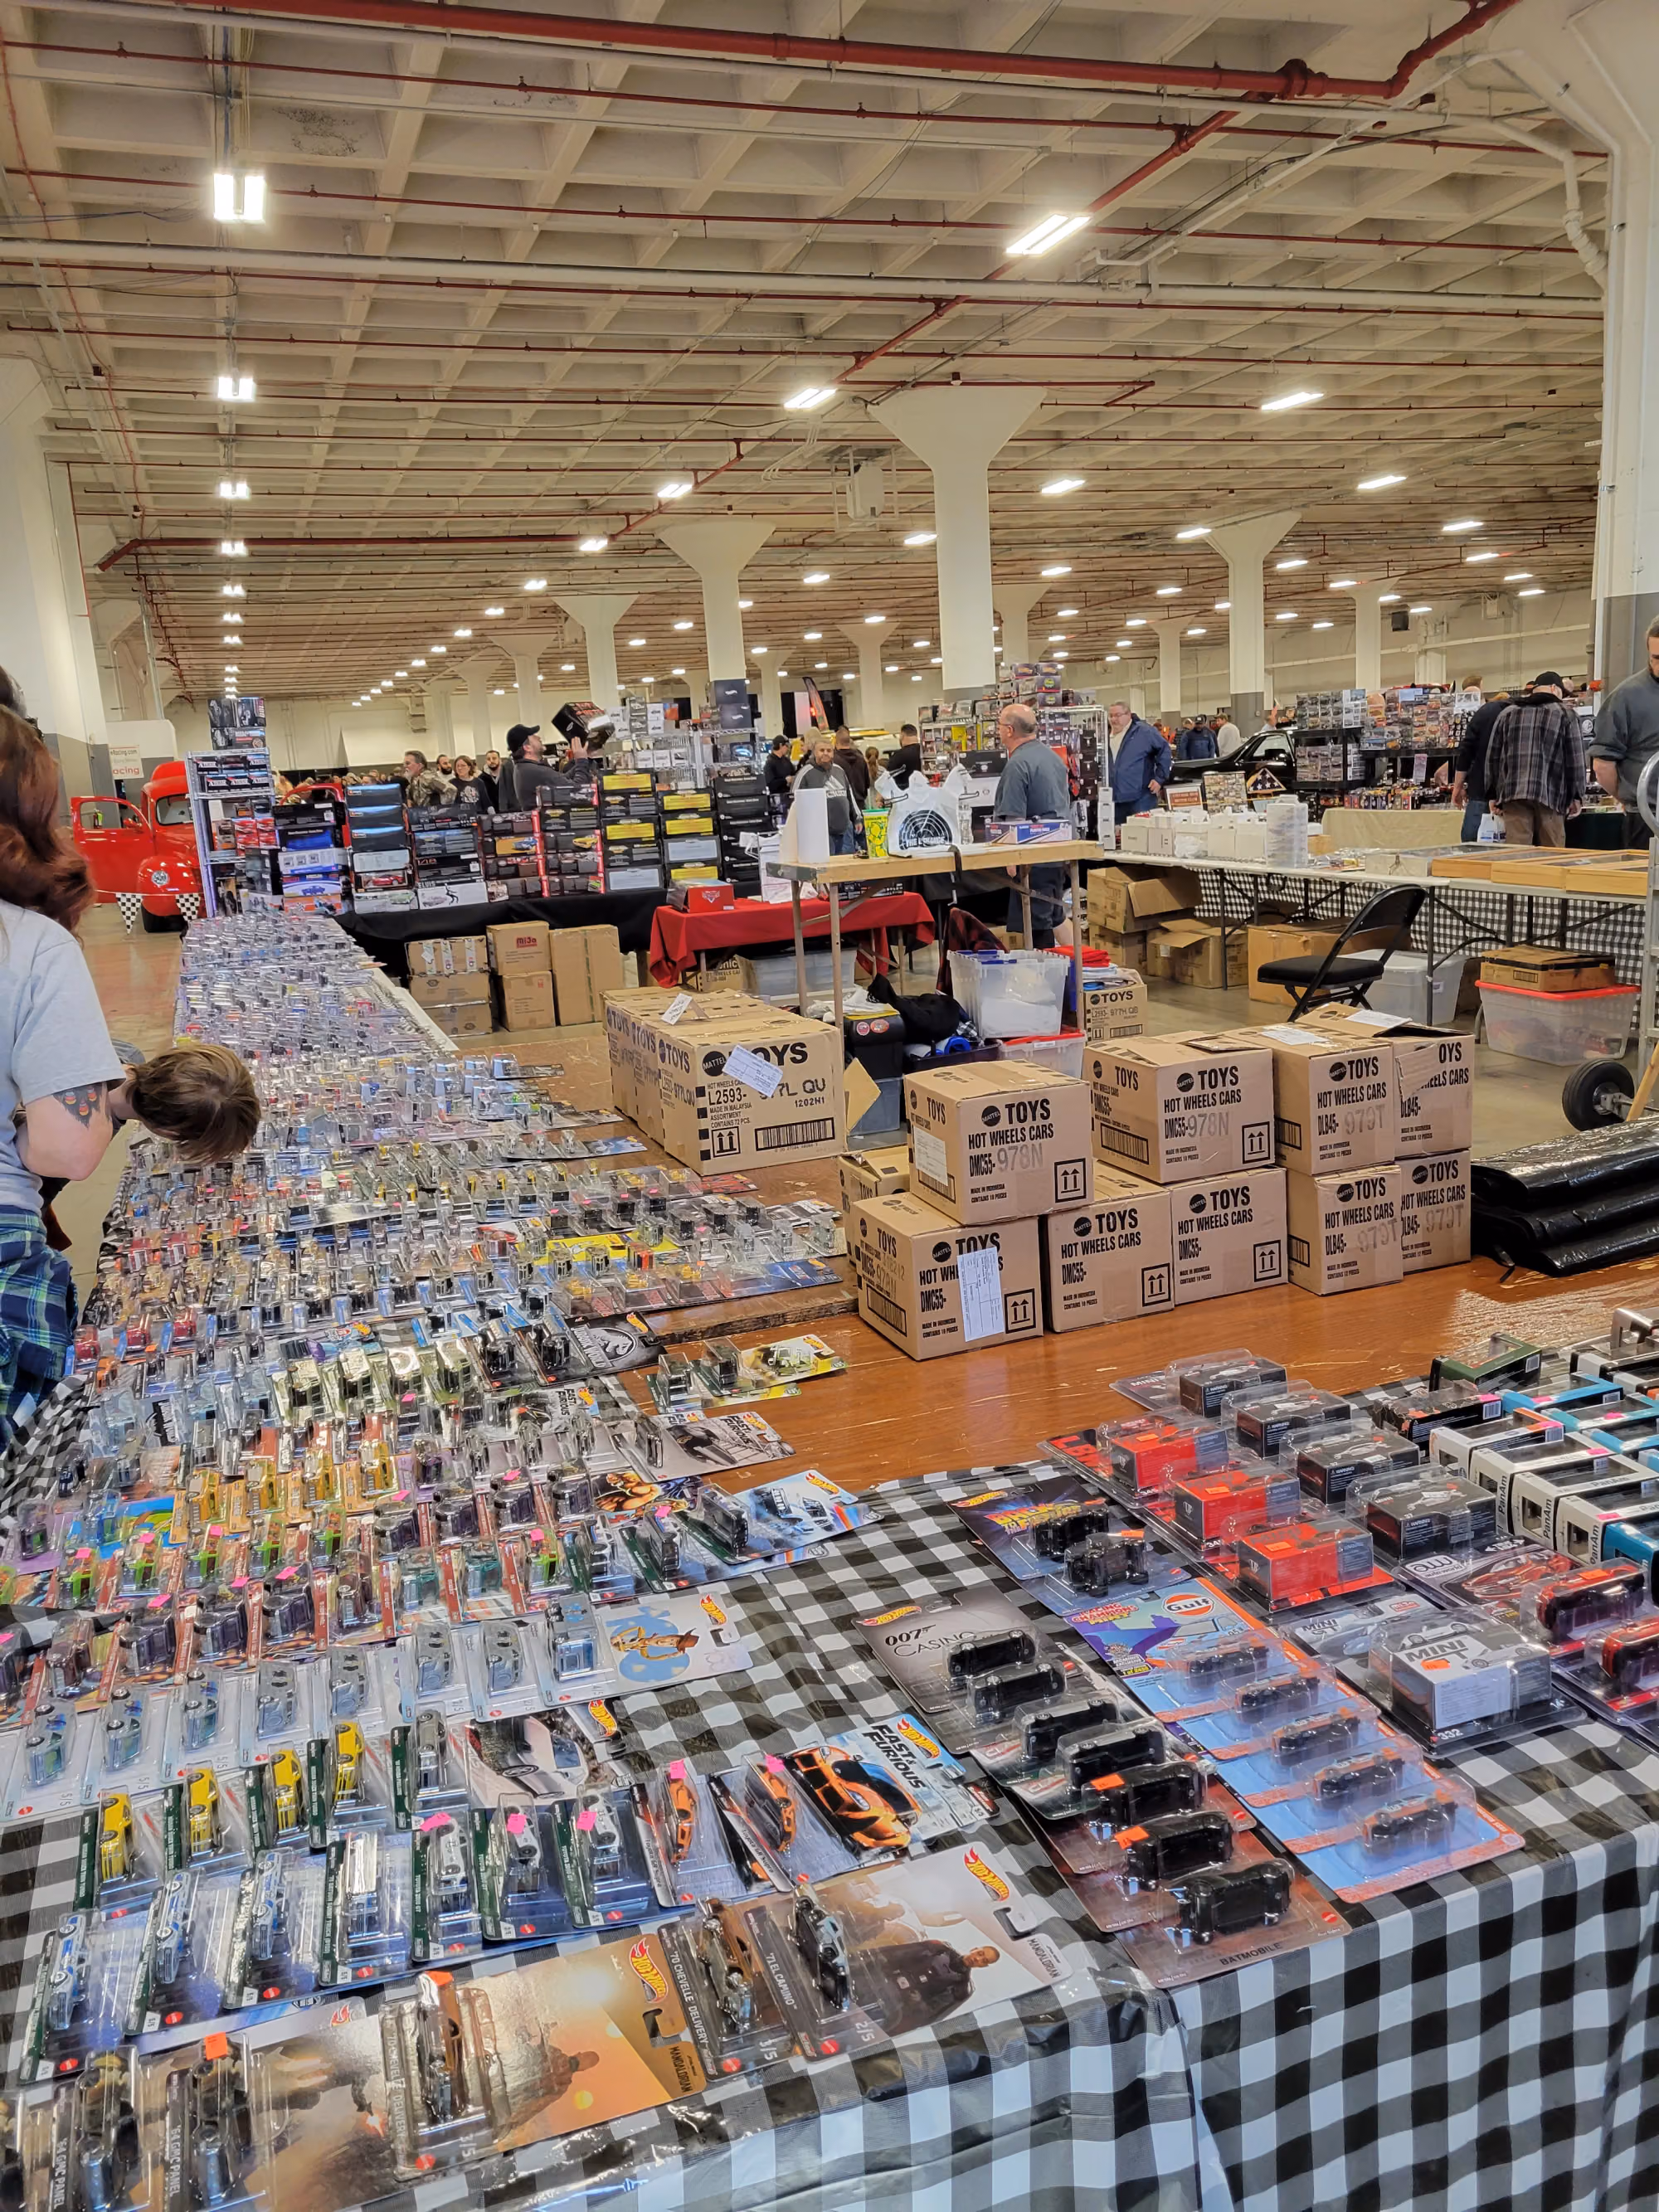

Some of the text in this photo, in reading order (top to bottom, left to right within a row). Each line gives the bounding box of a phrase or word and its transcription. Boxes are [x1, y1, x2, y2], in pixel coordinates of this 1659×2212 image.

[1101, 990, 1134, 1004] TOYS
[612, 1010, 630, 1037] TOYS
[636, 1025, 657, 1053] TOYS
[664, 1043, 690, 1074] TOYS
[703, 1057, 727, 1069] MATTEL
[1438, 1042, 1462, 1064] OYS
[1115, 1065, 1139, 1091] TOYS
[1198, 1065, 1239, 1091] TOYS
[1348, 1056, 1379, 1080] TOYS
[1449, 1067, 1469, 1085] CARS
[708, 1087, 747, 1106] L2593-
[729, 1102, 752, 1111] MALAYSIA
[1164, 1088, 1242, 1114] HOT WHEELS CARS
[1317, 1082, 1387, 1109] HOT WHEELS CARS
[710, 1111, 742, 1121] ASSORTMENT
[927, 1096, 946, 1125] TOYS
[1005, 1098, 1051, 1125] TOYS
[711, 1120, 734, 1128] CONTAINS
[968, 1123, 1054, 1150] HOT WHEELS CARS
[1165, 1116, 1188, 1140] DMC55-
[1318, 1113, 1339, 1136] DLB45-
[969, 1153, 995, 1178] DMC55-
[1429, 1159, 1459, 1183] TOYS
[1209, 1185, 1251, 1211] TOYS
[1355, 1176, 1386, 1201] TOYS
[1401, 1184, 1466, 1211] HOT WHEELS CARS
[1096, 1208, 1138, 1235] TOYS
[1178, 1208, 1253, 1235] HOT WHEELS CARS
[1325, 1202, 1394, 1229] HOT WHEELS CARS
[1401, 1215, 1420, 1237] DLB45-
[878, 1228, 897, 1258] TOYS
[1061, 1231, 1141, 1259] HOT WHEELS CARS
[1179, 1237, 1202, 1261] DMC55-
[1326, 1233, 1346, 1256] DLB45-
[919, 1268, 937, 1286] HOT
[1062, 1262, 1087, 1285] DMC55-
[920, 1288, 946, 1313] DMC55-
[1130, 1375, 1165, 1387] MINI
[556, 1391, 570, 1416] FURIOUS
[564, 1388, 577, 1404] FAST
[720, 1418, 753, 1444] FURIOUS
[727, 1415, 752, 1433] FAST
[1498, 1475, 1507, 1515] PanAm
[1543, 1499, 1552, 1539] PanAm
[1167, 1597, 1210, 1612] Gulf
[885, 1626, 927, 1646] 007
[1301, 1618, 1338, 1632] MINI
[1405, 1639, 1467, 1662] MINI
[871, 1724, 917, 1760] FAST
[1438, 1728, 1463, 1741] 332
[863, 1731, 927, 1790] FURIOUS
[1027, 1937, 1061, 1979] MANDALORIAN
[1219, 1942, 1284, 1966] BATMOBILE
[776, 1973, 795, 2007] CAMINO
[674, 1966, 695, 2003] CHEVELLE
[688, 2005, 709, 2044] DELIVERY
[669, 2045, 693, 2093] MANDALORIAN
[393, 2094, 406, 2138] DELIVERY
[170, 2142, 182, 2166] GMC
[52, 2176, 66, 2210] PANEL
[169, 2166, 182, 2198] PANEL
